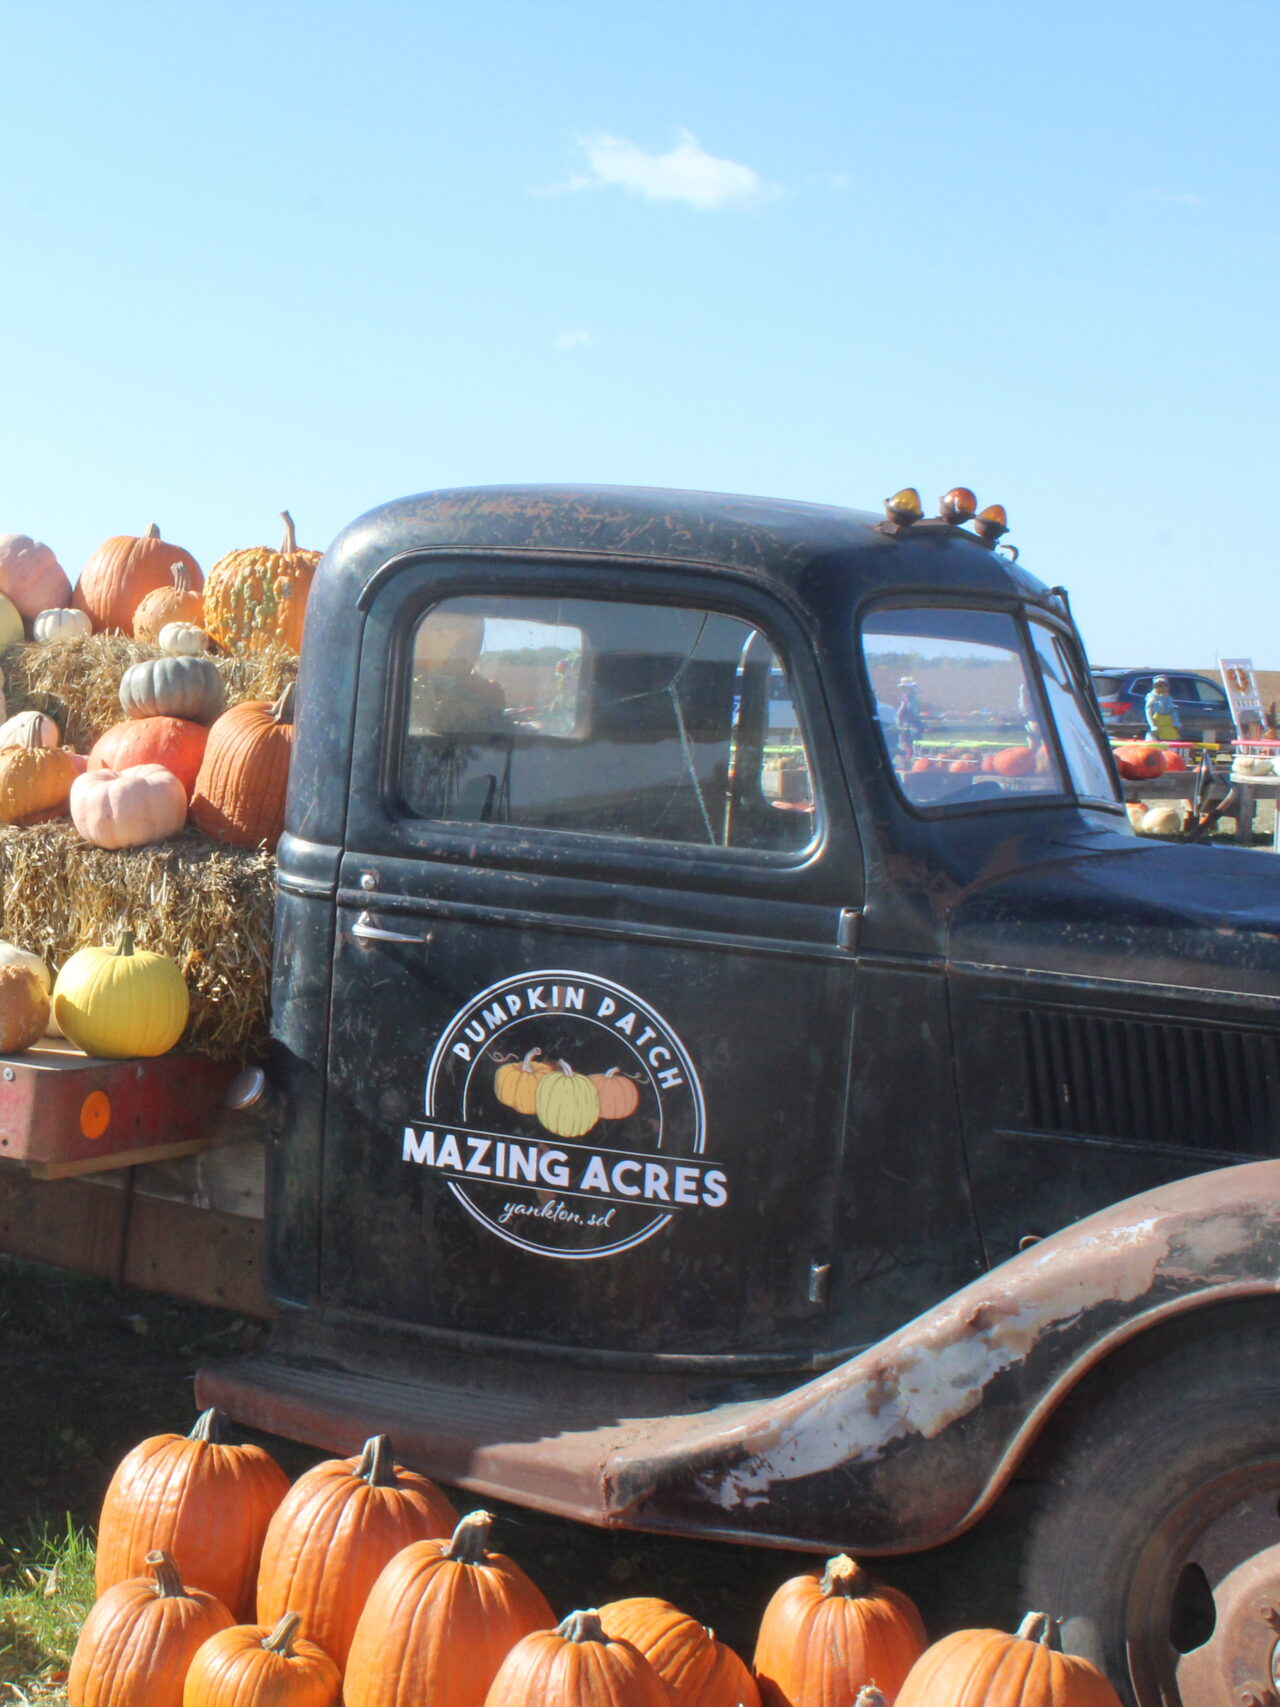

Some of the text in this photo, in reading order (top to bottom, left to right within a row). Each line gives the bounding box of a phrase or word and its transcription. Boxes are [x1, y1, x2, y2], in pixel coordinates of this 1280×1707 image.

[453, 986, 683, 1089] PUMPKIN PATCH
[402, 1127, 728, 1207] MAZING ACRES
[587, 1208, 616, 1227] sd
